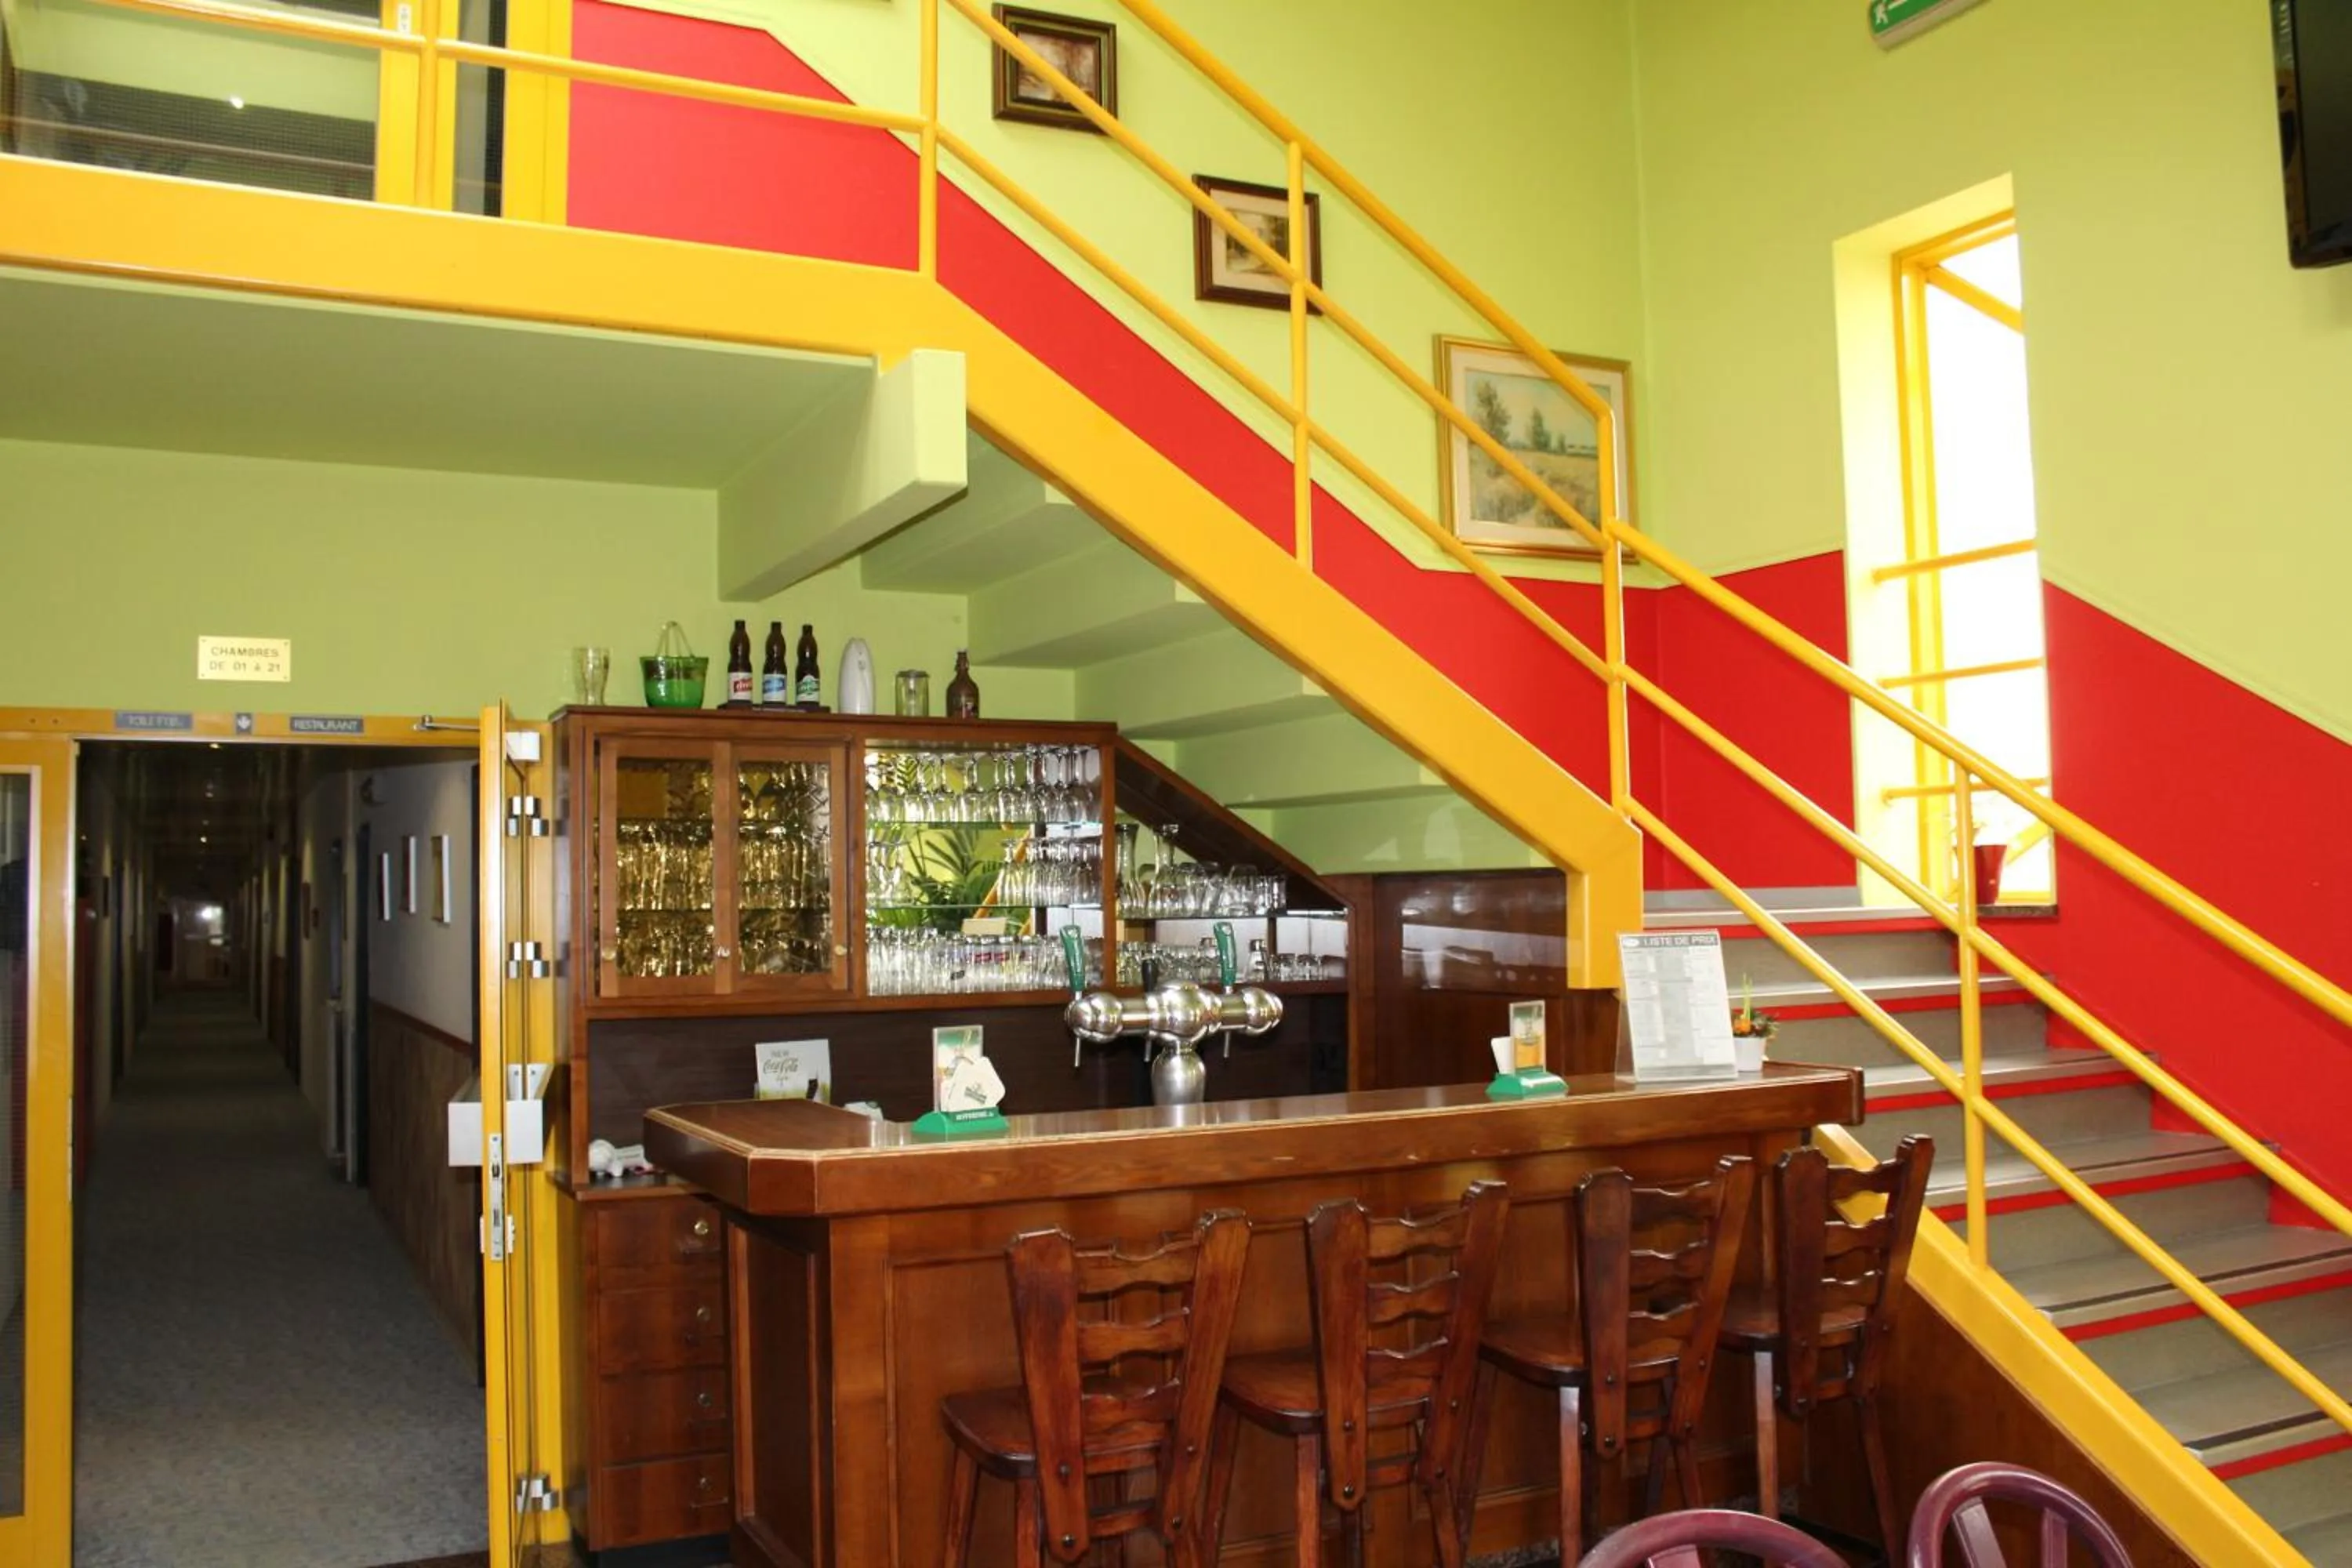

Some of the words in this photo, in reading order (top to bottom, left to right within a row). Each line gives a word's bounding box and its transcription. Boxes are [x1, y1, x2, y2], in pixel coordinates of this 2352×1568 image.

[210, 646, 279, 657] CHAMBRES
[209, 660, 225, 671] DE
[233, 661, 247, 672] 01
[267, 662, 281, 673] 21
[293, 718, 358, 731] RESTAURANT
[1643, 937, 1672, 946] LISTE
[1674, 936, 1690, 946] DE
[1692, 935, 1718, 946] PRIX
